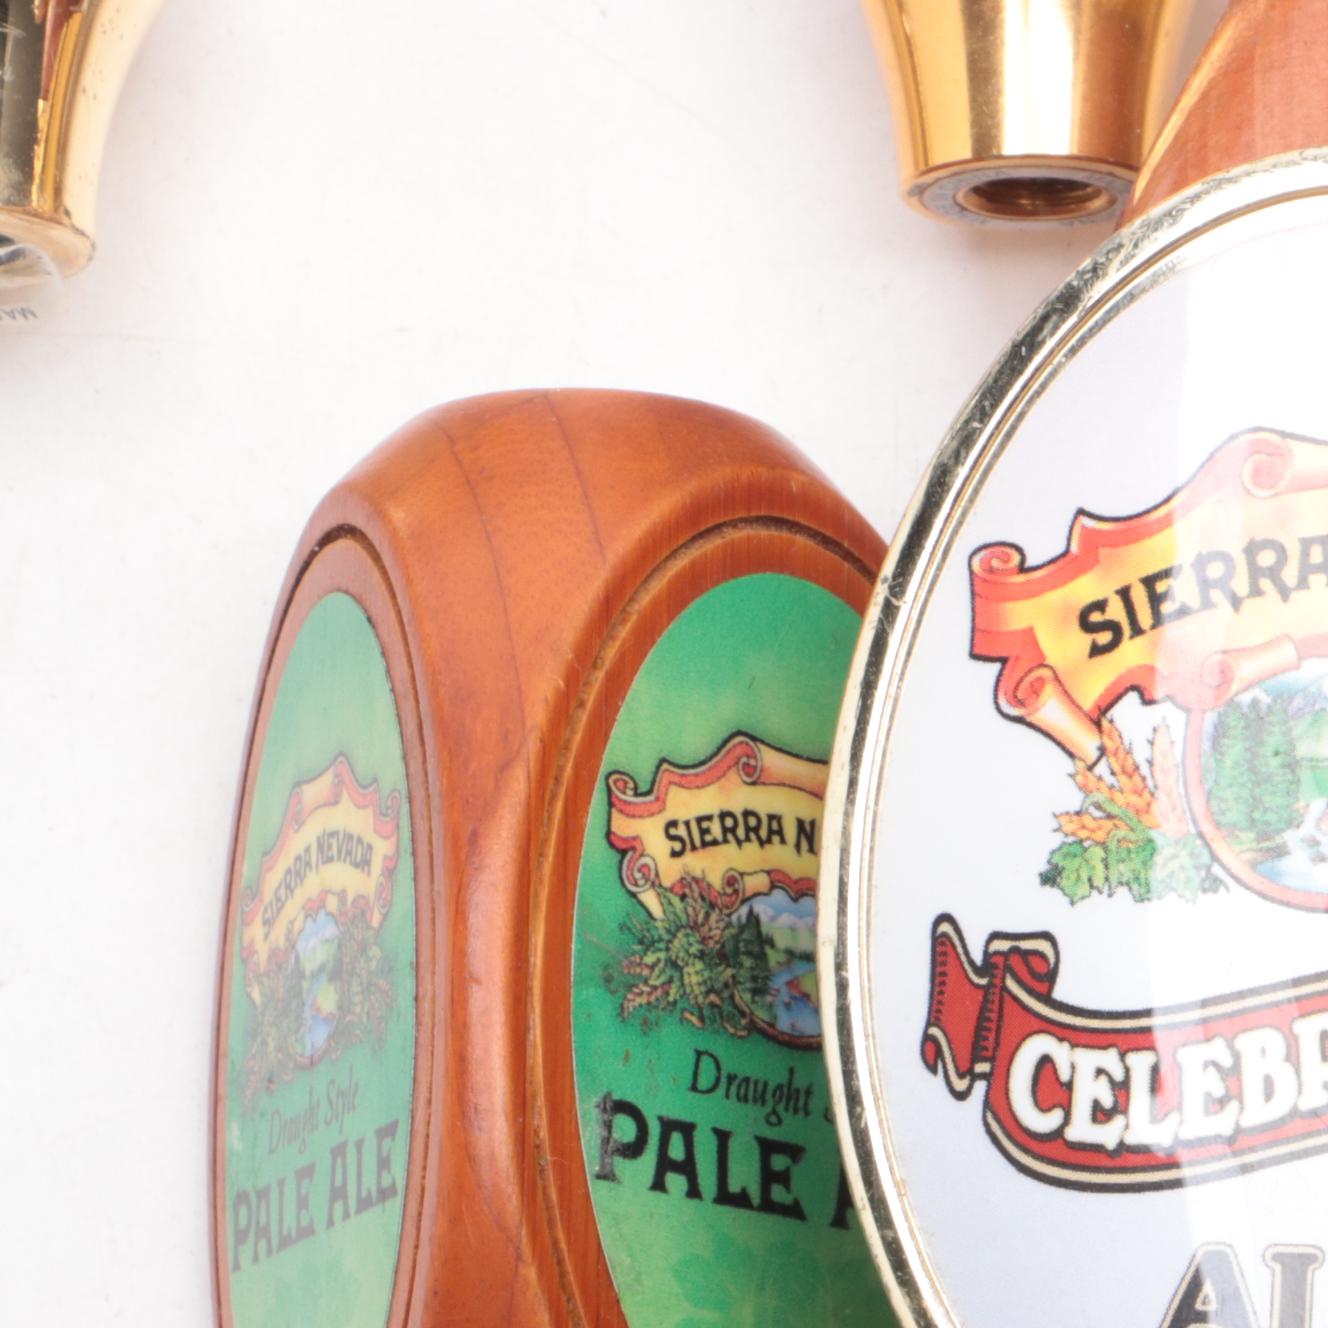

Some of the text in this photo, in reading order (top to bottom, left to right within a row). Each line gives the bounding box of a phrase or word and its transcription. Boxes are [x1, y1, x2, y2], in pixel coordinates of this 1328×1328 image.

[664, 808, 786, 858] SIERRA
[262, 827, 373, 942] SIERRA NEVADA
[268, 1065, 359, 1155] Draught Style
[688, 1048, 814, 1126] Draught
[231, 1119, 399, 1273] PALE ALE
[595, 1090, 807, 1223] PALE
